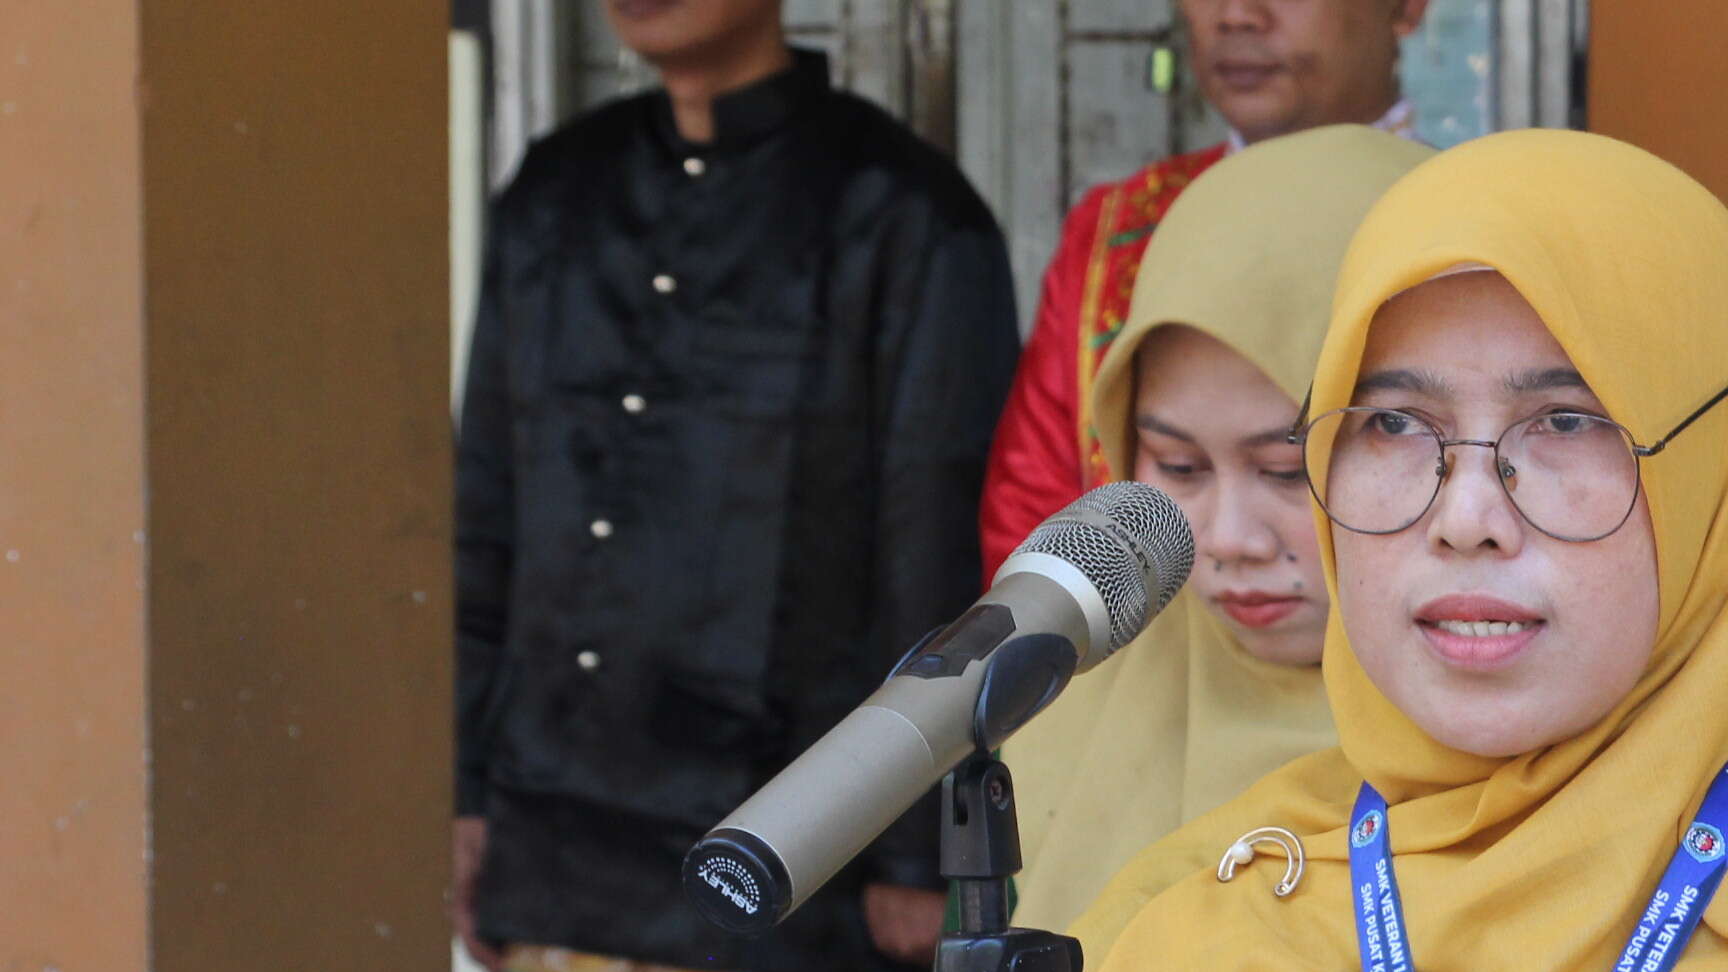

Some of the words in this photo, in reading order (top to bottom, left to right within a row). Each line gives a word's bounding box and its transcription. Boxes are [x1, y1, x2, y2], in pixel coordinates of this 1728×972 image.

[698, 869, 758, 914] ASHLEY
[1375, 858, 1390, 895] SMK
[1360, 882, 1374, 914] SMK
[1642, 889, 1670, 925] SMK
[1669, 884, 1699, 922] SMK
[1365, 914, 1382, 960] PUSAT
[1380, 891, 1404, 963] VETERAN
